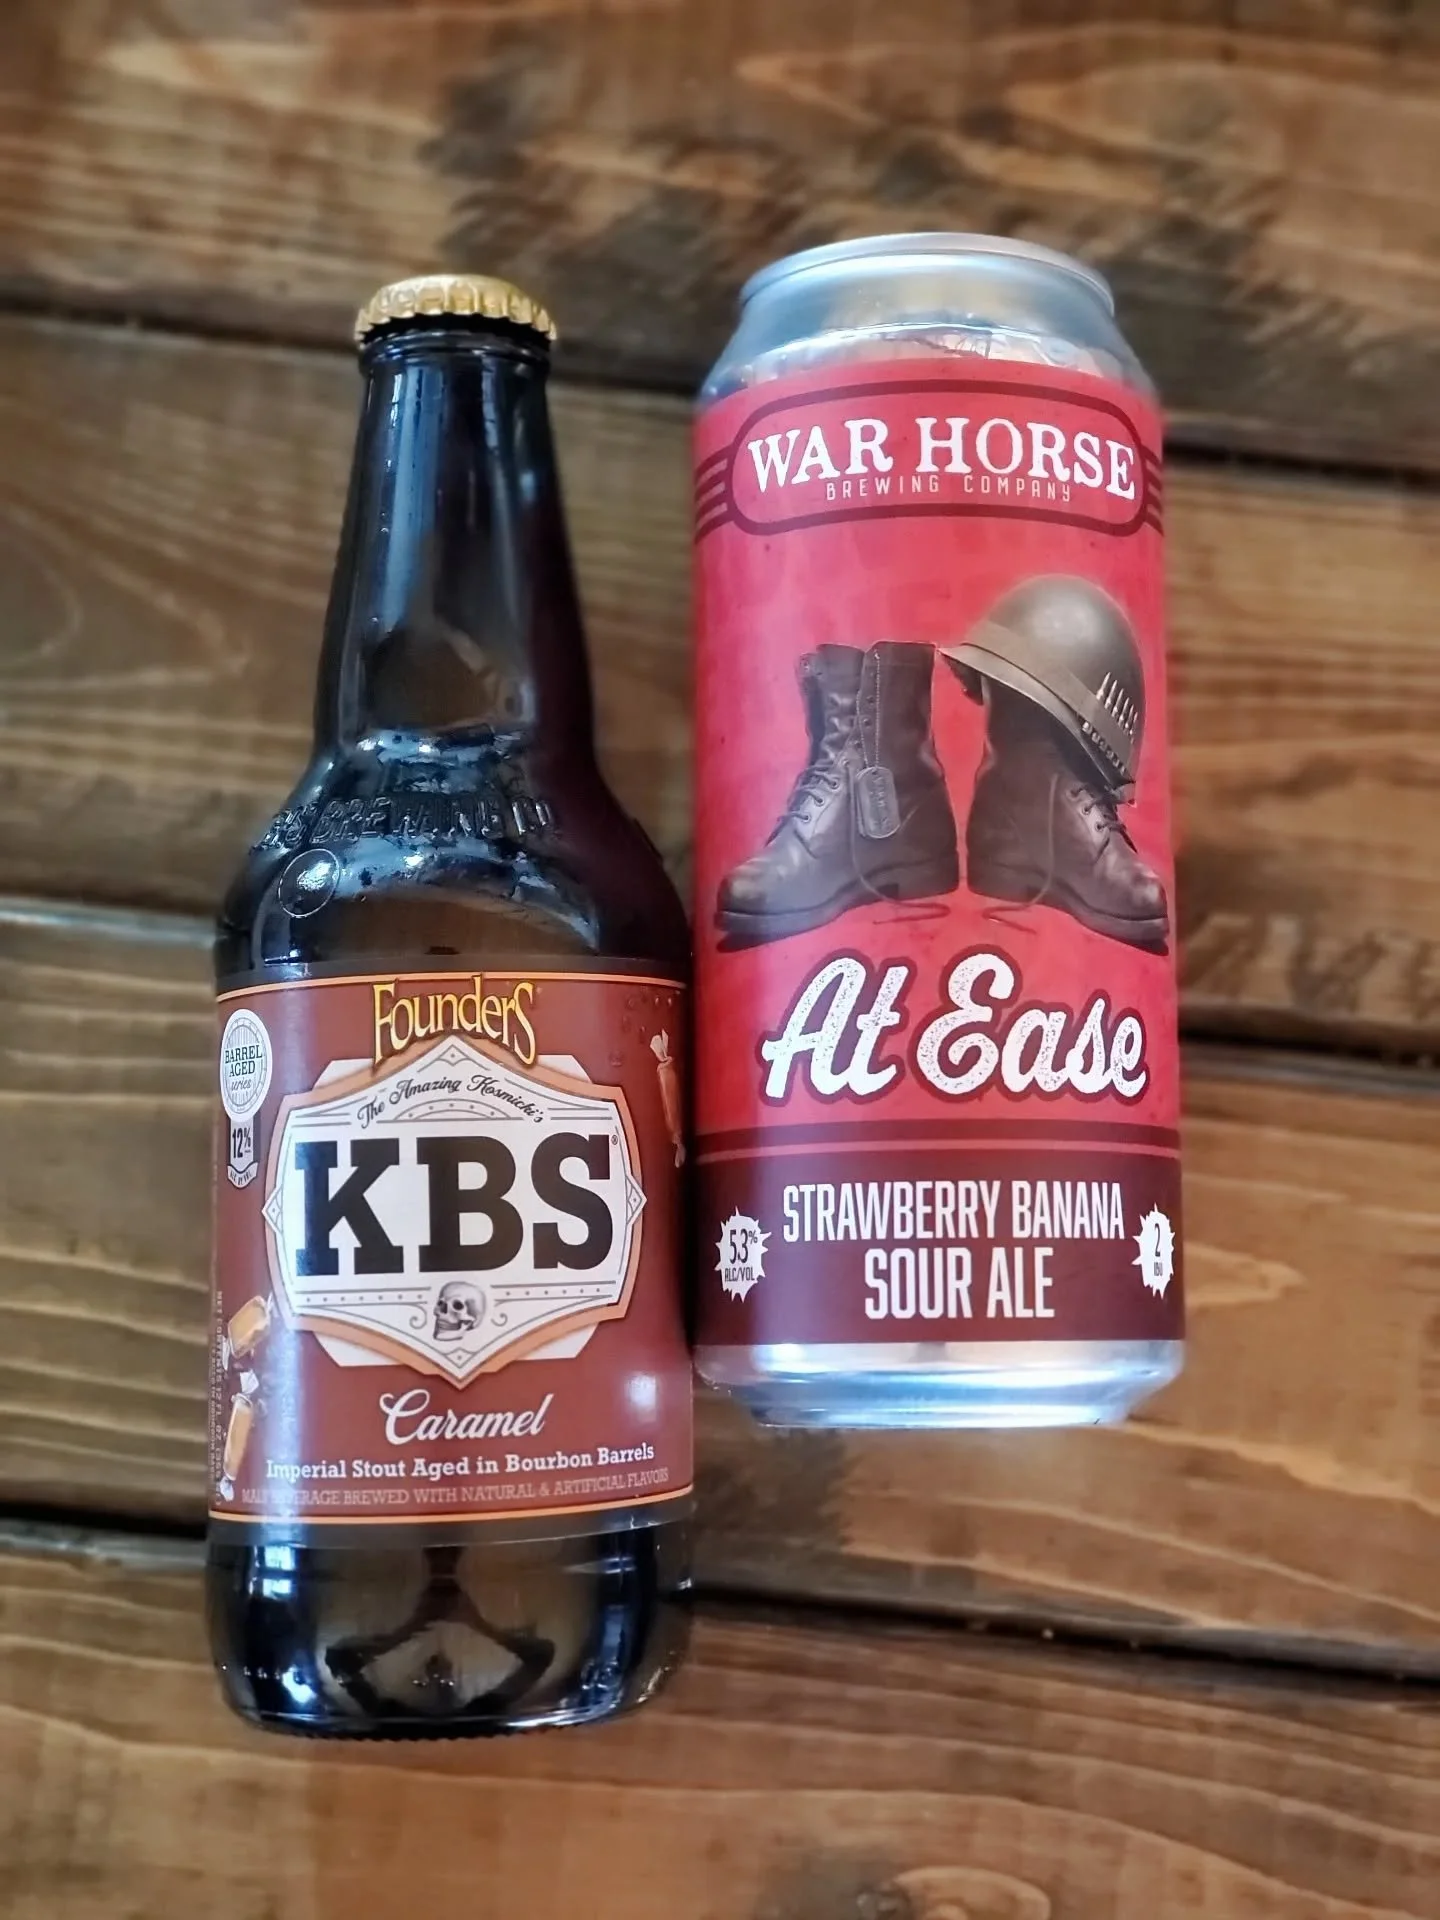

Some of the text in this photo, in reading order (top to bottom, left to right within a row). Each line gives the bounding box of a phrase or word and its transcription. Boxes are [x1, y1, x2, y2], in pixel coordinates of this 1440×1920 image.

[747, 417, 1136, 499] WAR HORSE
[825, 474, 1071, 502] BREWING COMPANY
[371, 975, 538, 1066] Founders
[761, 952, 1147, 1099] At Ease
[224, 1045, 263, 1064] BARREL
[228, 1060, 256, 1078] AGED
[357, 1074, 544, 1129] The Amazing Kosmicki's
[294, 1131, 614, 1277] KBS
[782, 1180, 1125, 1242] STRAWBERRY BANANA
[1154, 1222, 1161, 1258] 2
[724, 1266, 755, 1282] ALC/VOL
[864, 1246, 1056, 1319] SOUR ALE
[379, 1389, 555, 1445] Caramel
[266, 1442, 655, 1482] Imperial Stout Aged in Bourbon Barrels
[271, 1489, 340, 1506] ERAGE
[343, 1488, 410, 1506] BREWED
[413, 1487, 457, 1504] WITH
[461, 1482, 537, 1502] NATURAL
[538, 1482, 551, 1497] &
[553, 1475, 626, 1496] ARTIFICIAL
[627, 1467, 669, 1489] FLAVORS
